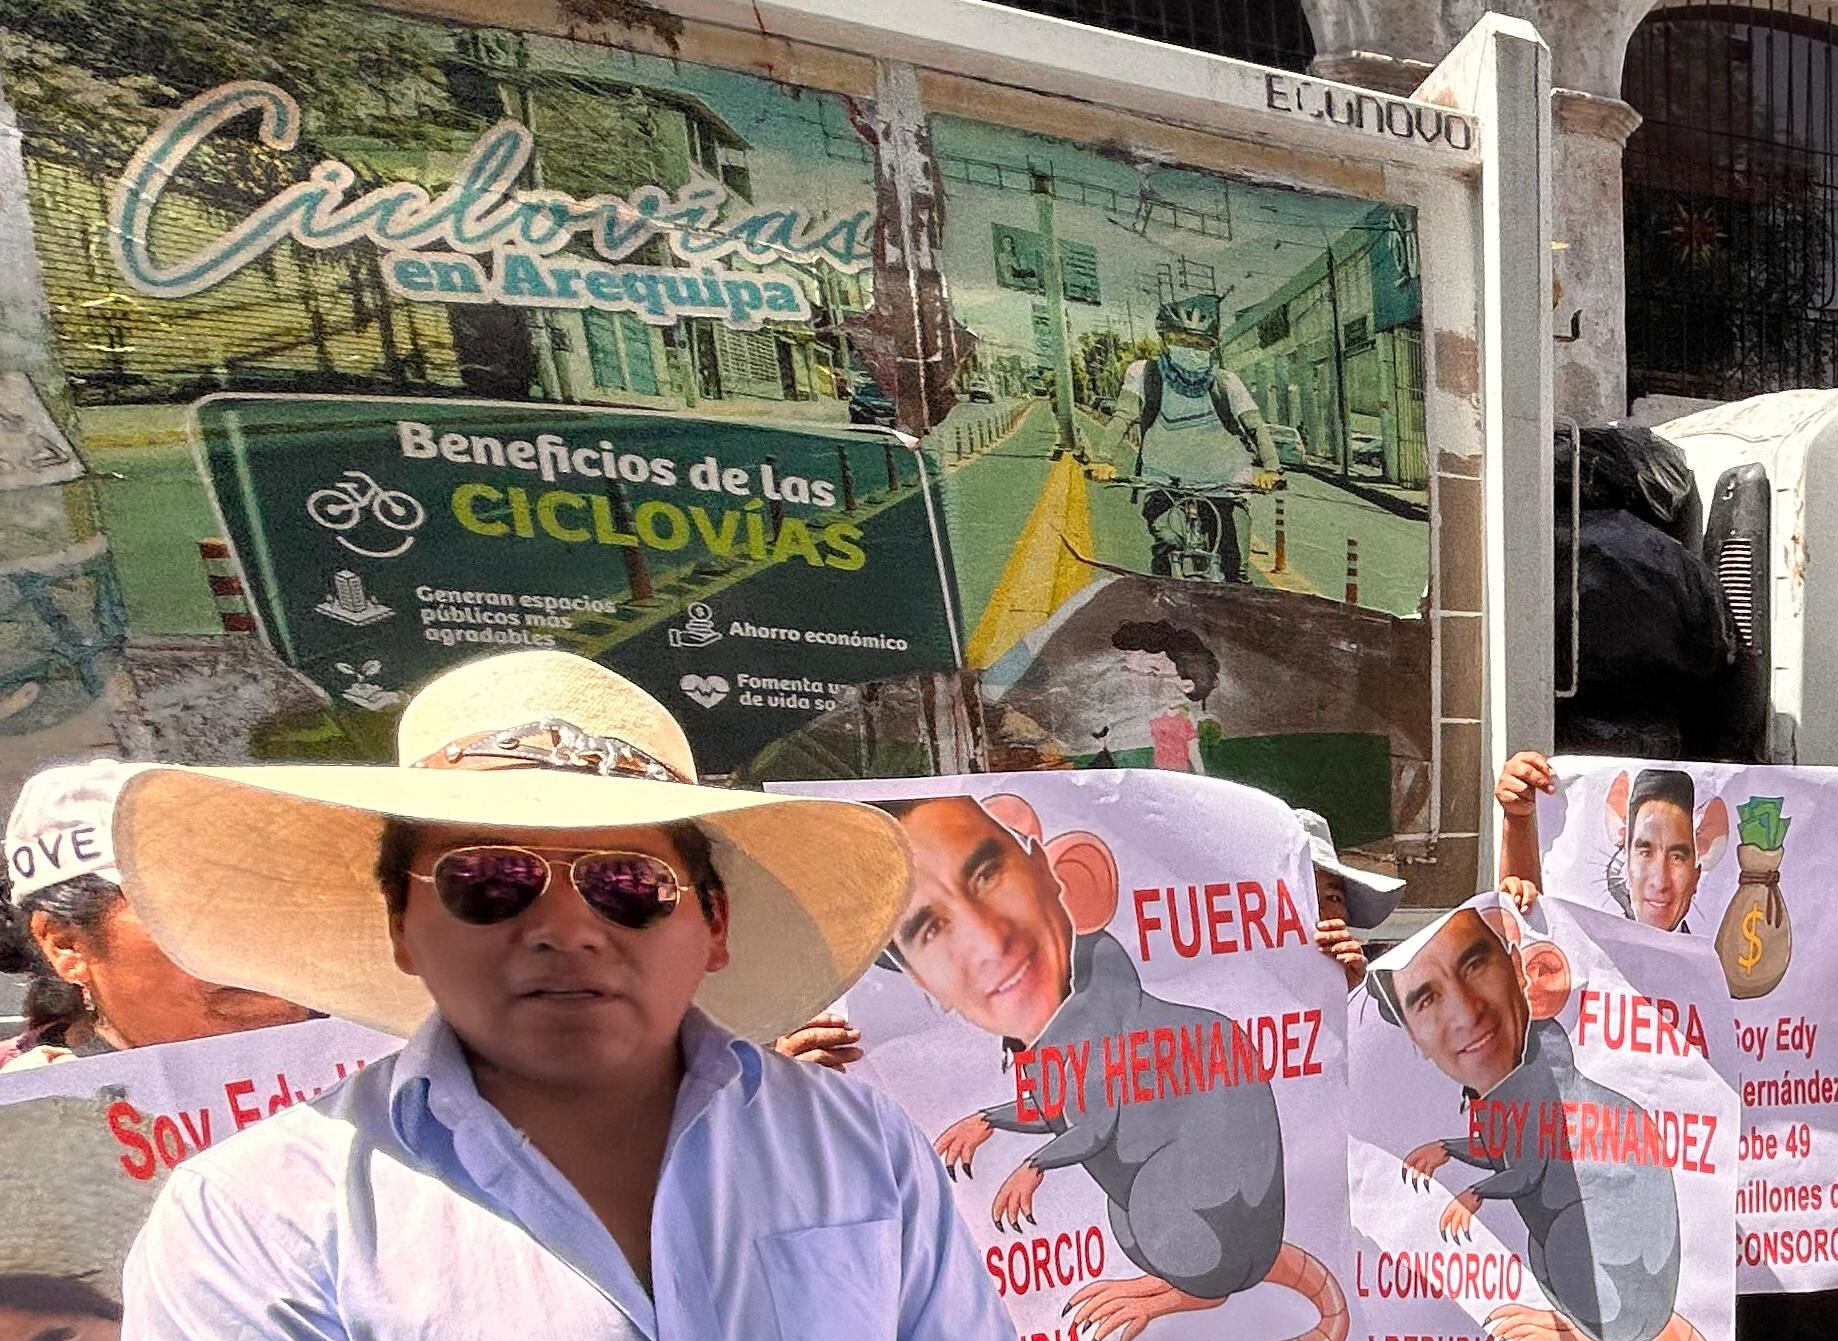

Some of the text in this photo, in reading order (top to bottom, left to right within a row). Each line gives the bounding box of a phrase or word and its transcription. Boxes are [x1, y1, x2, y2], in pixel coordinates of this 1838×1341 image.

[395, 252, 797, 317] en Arequipa
[397, 421, 835, 507] Beneficios de las
[451, 482, 867, 571] CICLOVÍAS
[416, 585, 617, 616] Generan espacios
[419, 603, 520, 626] públicos
[425, 627, 556, 646] agradables
[729, 621, 909, 652] Ahorro económico
[737, 673, 824, 694] Fomenta
[739, 691, 764, 707] de
[768, 693, 811, 710] vida
[1133, 879, 1308, 961] FUERA
[1578, 990, 1710, 1060] FUERA
[1775, 1016, 1817, 1060] Edy
[1013, 1009, 1323, 1124] EDY HERNANDEZ
[1467, 1097, 1718, 1175] EDY HERNANDEZ
[1785, 1123, 1811, 1159] 49
[1377, 1251, 1523, 1300] CONSORCIO
